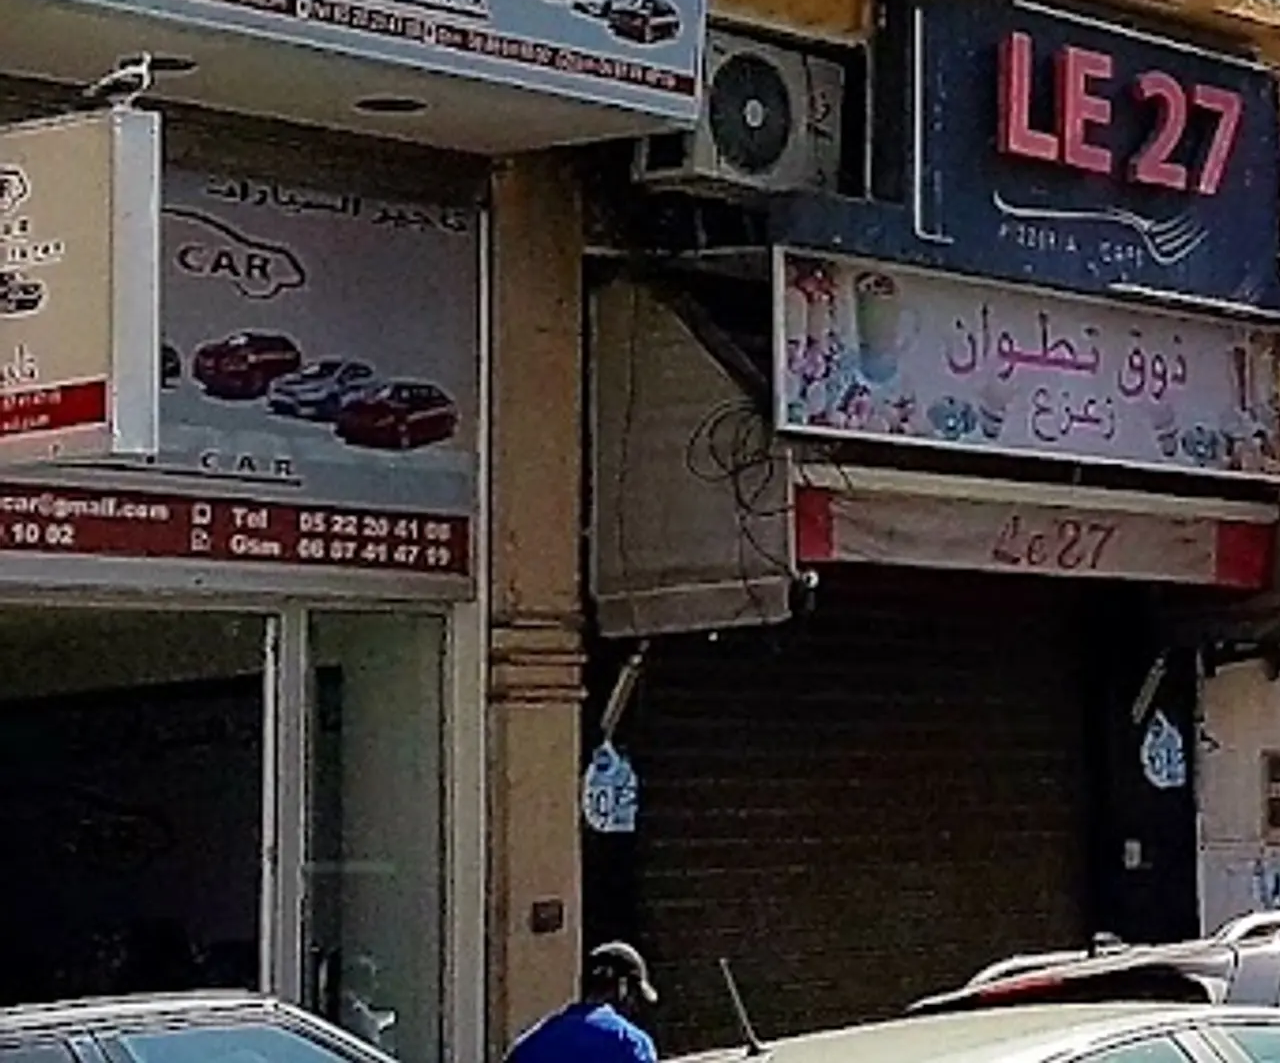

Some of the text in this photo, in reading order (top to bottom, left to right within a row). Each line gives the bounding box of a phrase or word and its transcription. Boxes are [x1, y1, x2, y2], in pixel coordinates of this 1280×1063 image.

[998, 30, 1243, 196] LE 27
[177, 244, 273, 283] CAR
[947, 303, 1101, 381] تطوان
[201, 452, 292, 476] CAR
